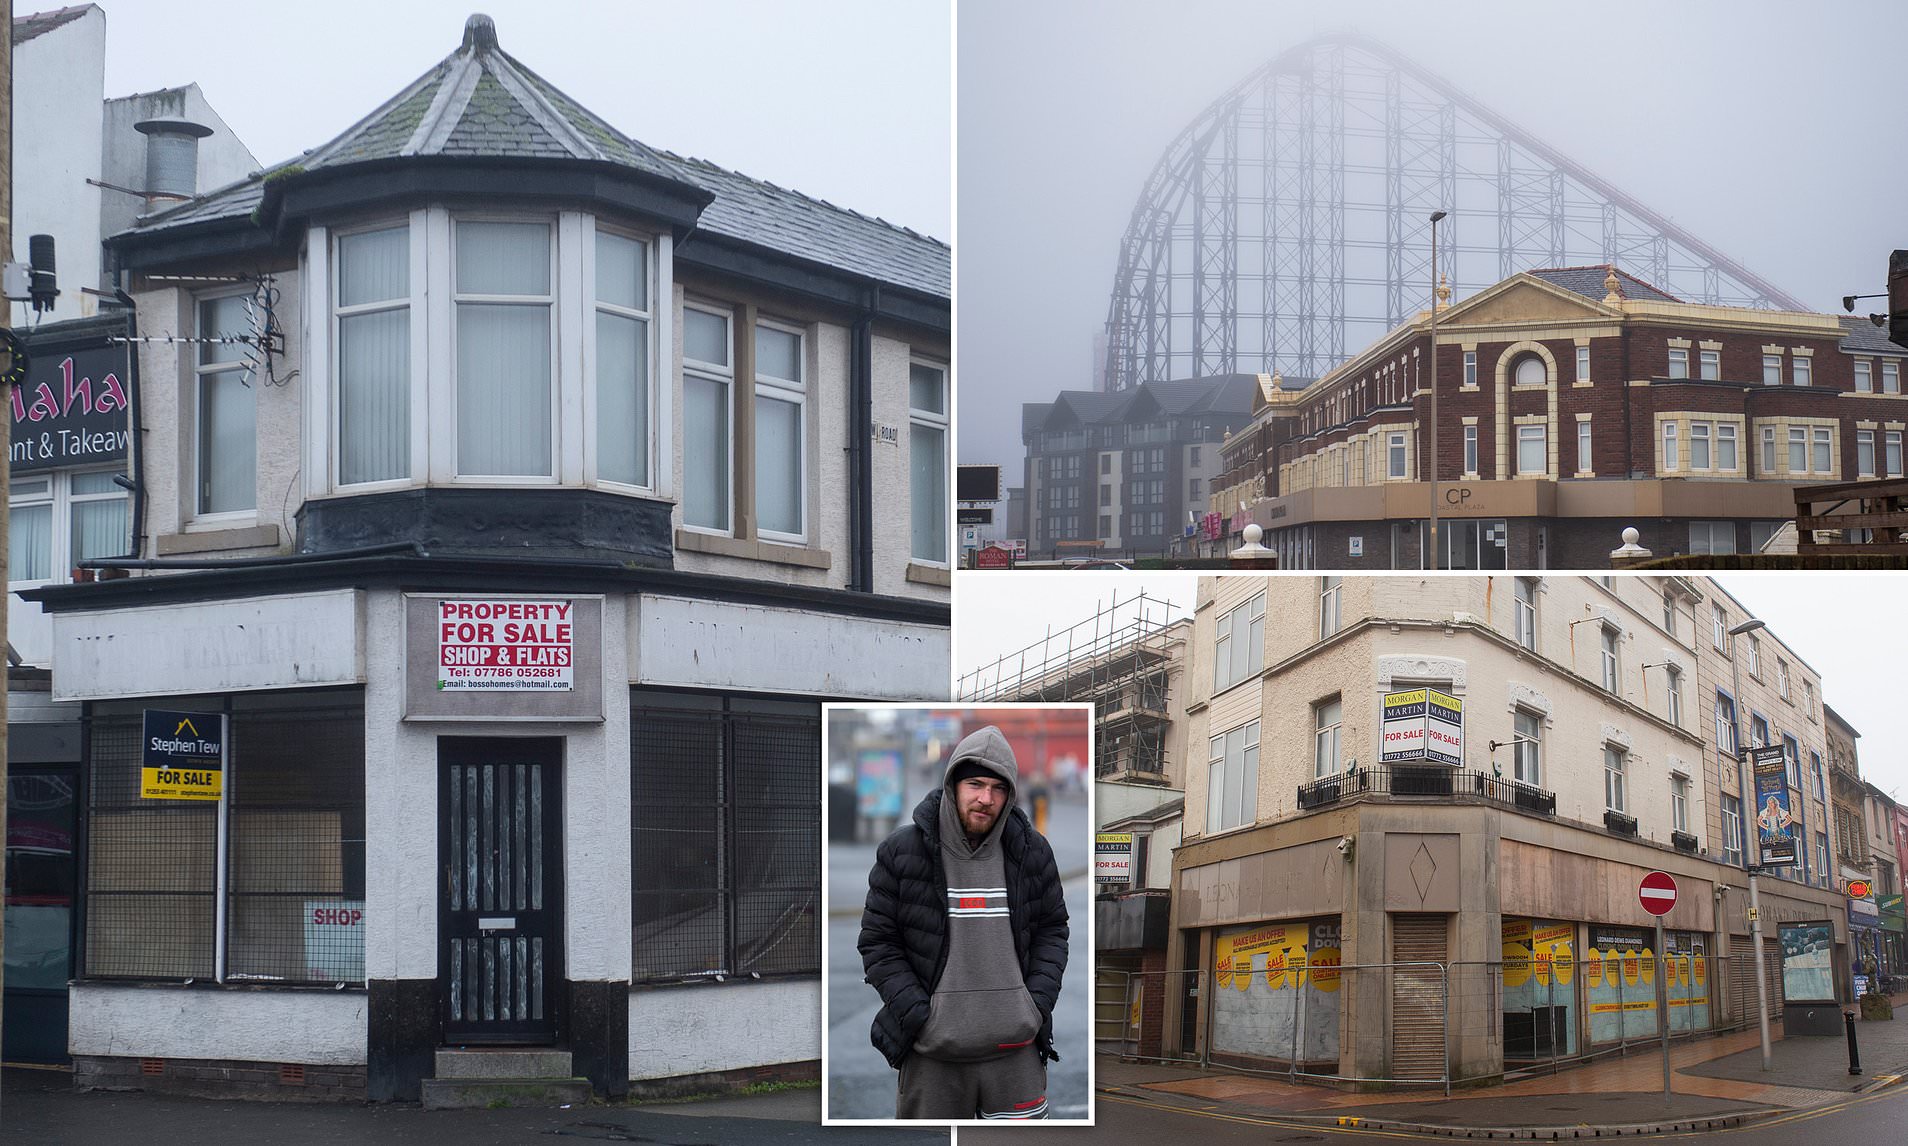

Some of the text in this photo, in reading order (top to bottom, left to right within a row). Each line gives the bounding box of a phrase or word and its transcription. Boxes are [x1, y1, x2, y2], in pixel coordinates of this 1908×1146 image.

[39, 432, 54, 458] &
[1446, 488, 1471, 504] CP
[442, 604, 570, 619] PROPERTY
[442, 623, 571, 643] FOR SALE
[444, 647, 568, 665] SHOP & FLATS
[448, 668, 561, 677] Tel: 07786 052681
[443, 680, 569, 688] Email: bossohomes@hotmail.com
[1387, 692, 1424, 705] MORGAN
[1431, 693, 1460, 710] MORGAN
[1387, 704, 1424, 717] MARTIN
[1431, 706, 1459, 721] MARTIN
[1385, 729, 1424, 742] FOR SALE
[1429, 730, 1459, 746] FOR SALE
[151, 737, 220, 755] Stephen Tew
[1384, 750, 1423, 760] 01772 556666
[157, 771, 212, 785] FOR SALE
[314, 908, 362, 926] SHOP
[1750, 909, 1757, 919] H
[1233, 935, 1249, 947] MAKE
[1249, 933, 1257, 944] US
[1257, 930, 1266, 941] AN
[1218, 956, 1231, 969] SALE
[1267, 954, 1284, 969] SALE
[1535, 953, 1553, 961] SALE
